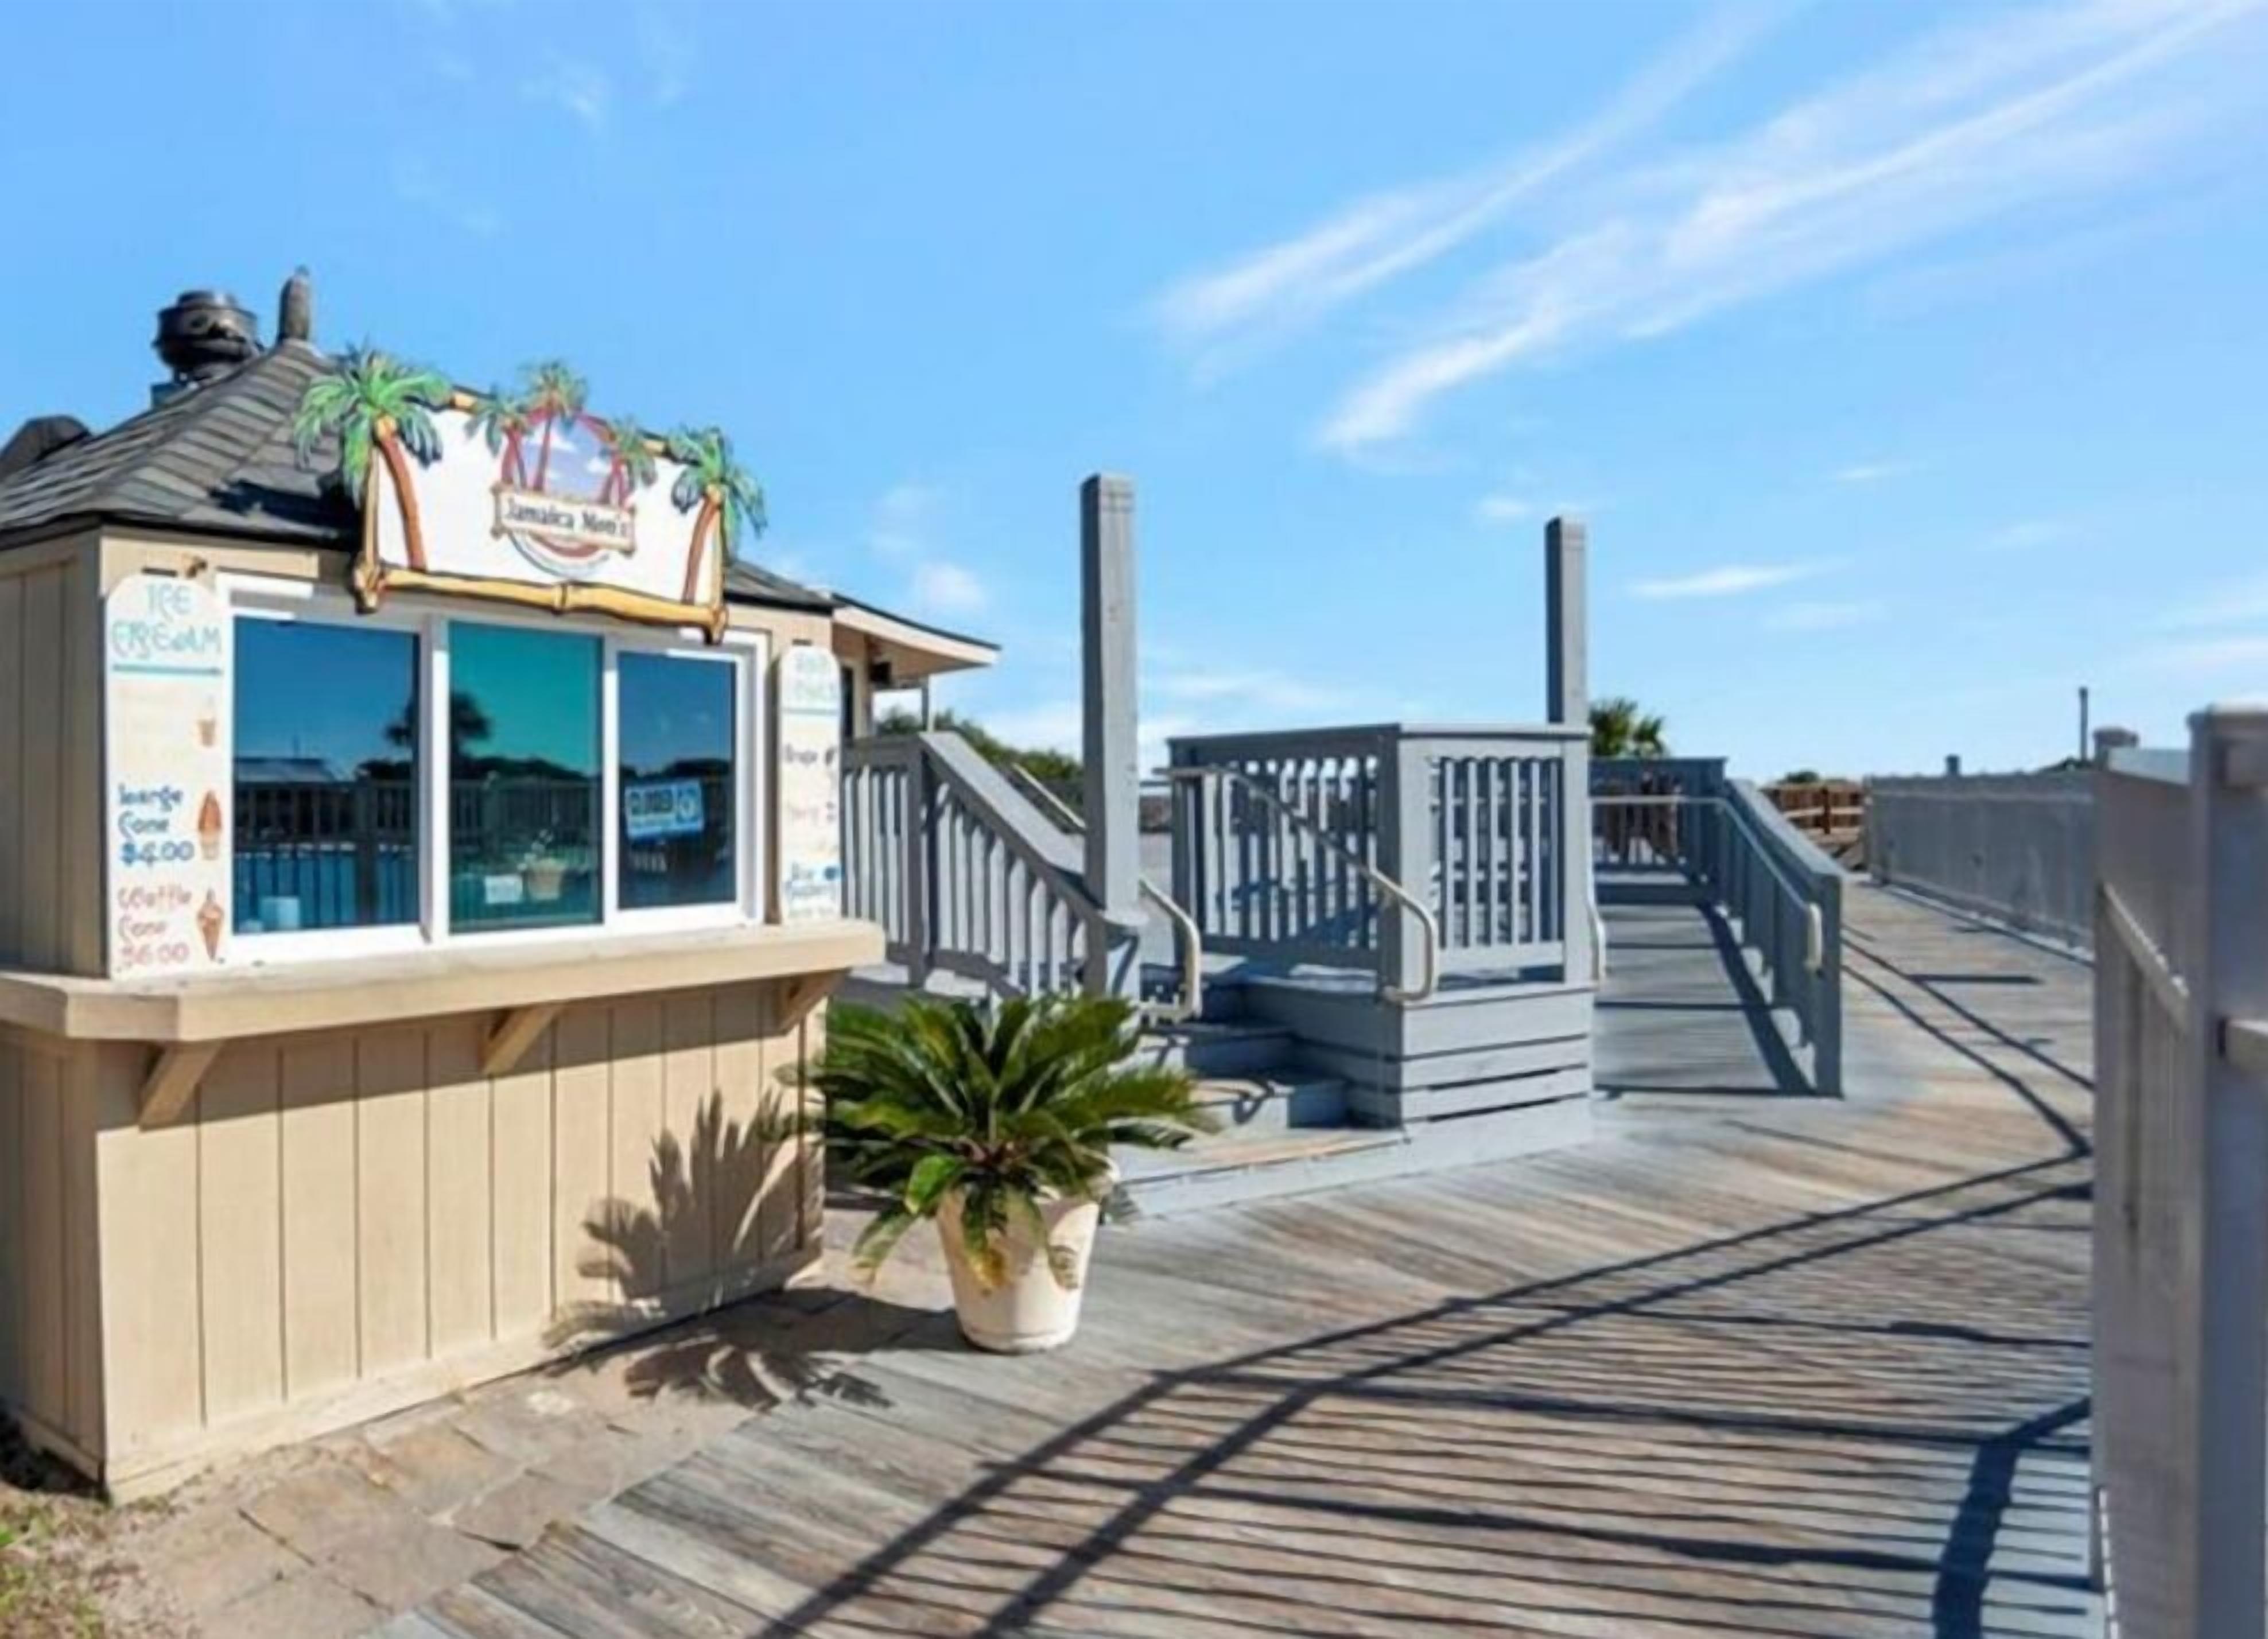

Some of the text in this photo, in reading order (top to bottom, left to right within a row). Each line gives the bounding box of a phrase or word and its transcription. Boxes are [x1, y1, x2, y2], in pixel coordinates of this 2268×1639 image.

[506, 497, 574, 529] Jamaica
[146, 582, 194, 622] ICE
[121, 840, 195, 869] $4.00
